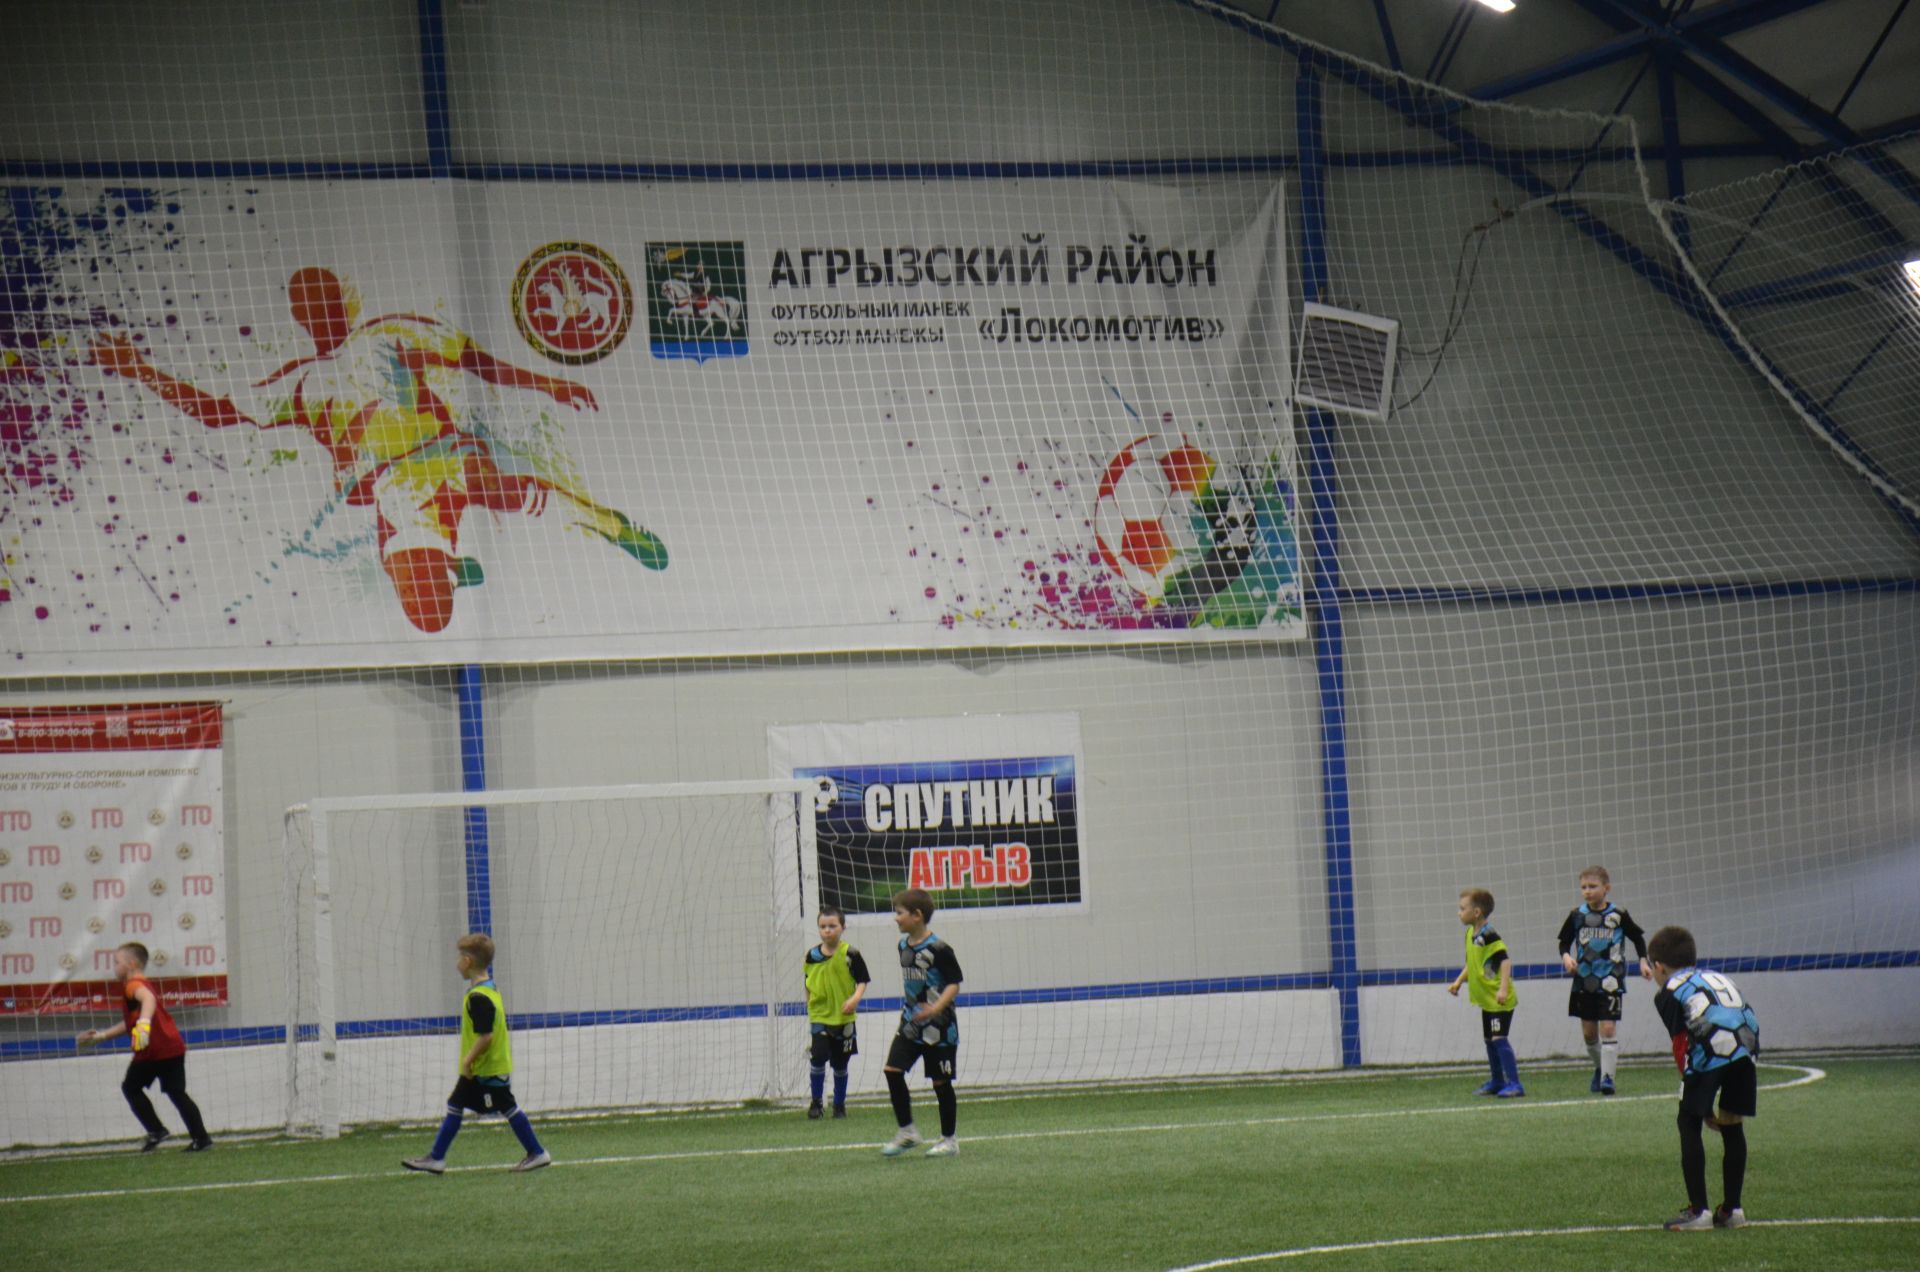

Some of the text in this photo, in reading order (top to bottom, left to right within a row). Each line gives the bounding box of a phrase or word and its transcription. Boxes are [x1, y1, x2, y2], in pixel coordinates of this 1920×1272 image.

[769, 233, 1216, 288] АГРЫЗСКИЙ РАЙОН
[904, 301, 970, 318] МАНЕЖ
[773, 330, 850, 346] ФУТБОЛ
[0, 769, 145, 780] ИЗКУЛЬТУРНО-СПОРТИВНЫЙ
[864, 775, 1056, 832] СПУТНИК
[91, 808, 124, 829] ГТО
[181, 805, 212, 826] ГТО
[28, 845, 61, 866] ГТО
[119, 843, 152, 864] ГТО
[908, 842, 1031, 890] АГРЫЗ
[1, 882, 33, 903] ГТО
[93, 879, 125, 899] ГТО
[182, 875, 214, 896] ГТО
[29, 917, 62, 938] ГТО
[121, 913, 152, 933] ГТО
[2, 954, 34, 975] ГТО
[94, 949, 117, 970] ГТ
[185, 946, 216, 966] ГТО
